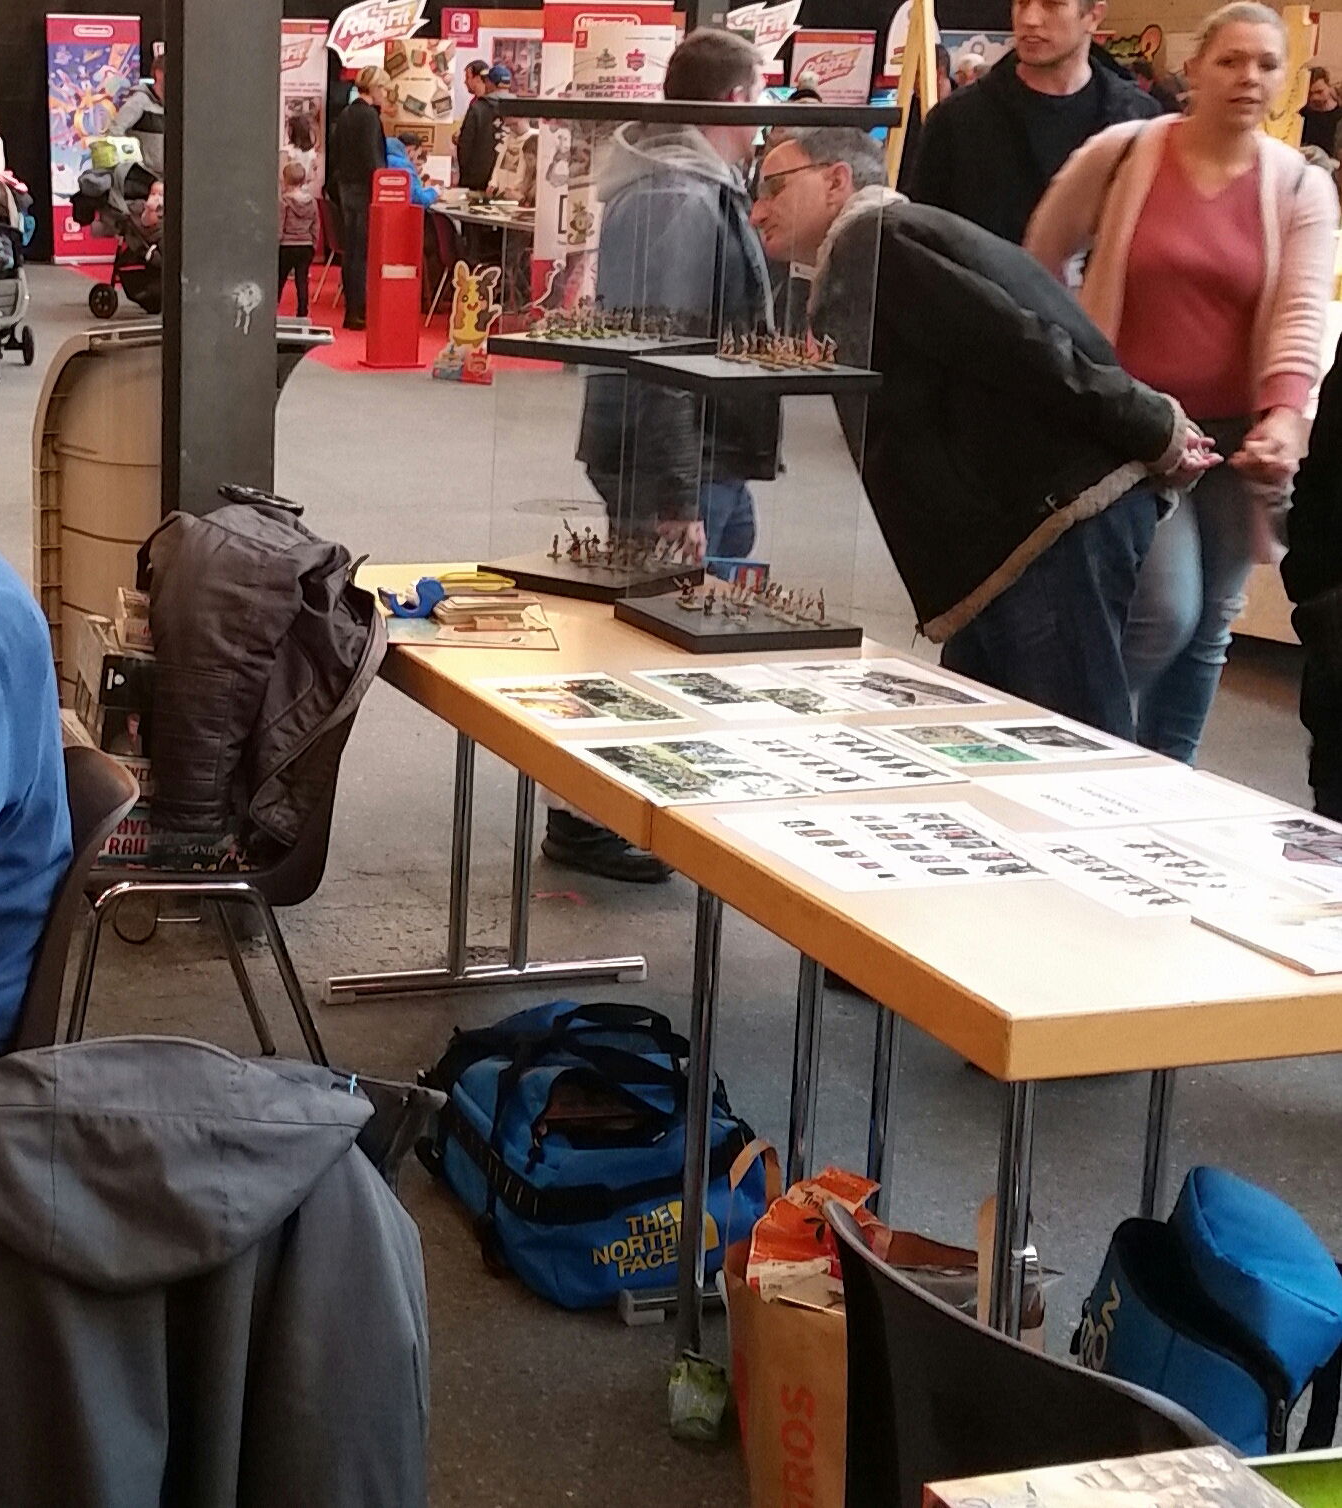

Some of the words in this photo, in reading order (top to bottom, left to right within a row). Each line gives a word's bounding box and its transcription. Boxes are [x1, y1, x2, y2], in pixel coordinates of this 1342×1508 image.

[626, 1204, 674, 1236] THE
[592, 1227, 676, 1266] NORTH
[618, 1246, 679, 1279] FACE
